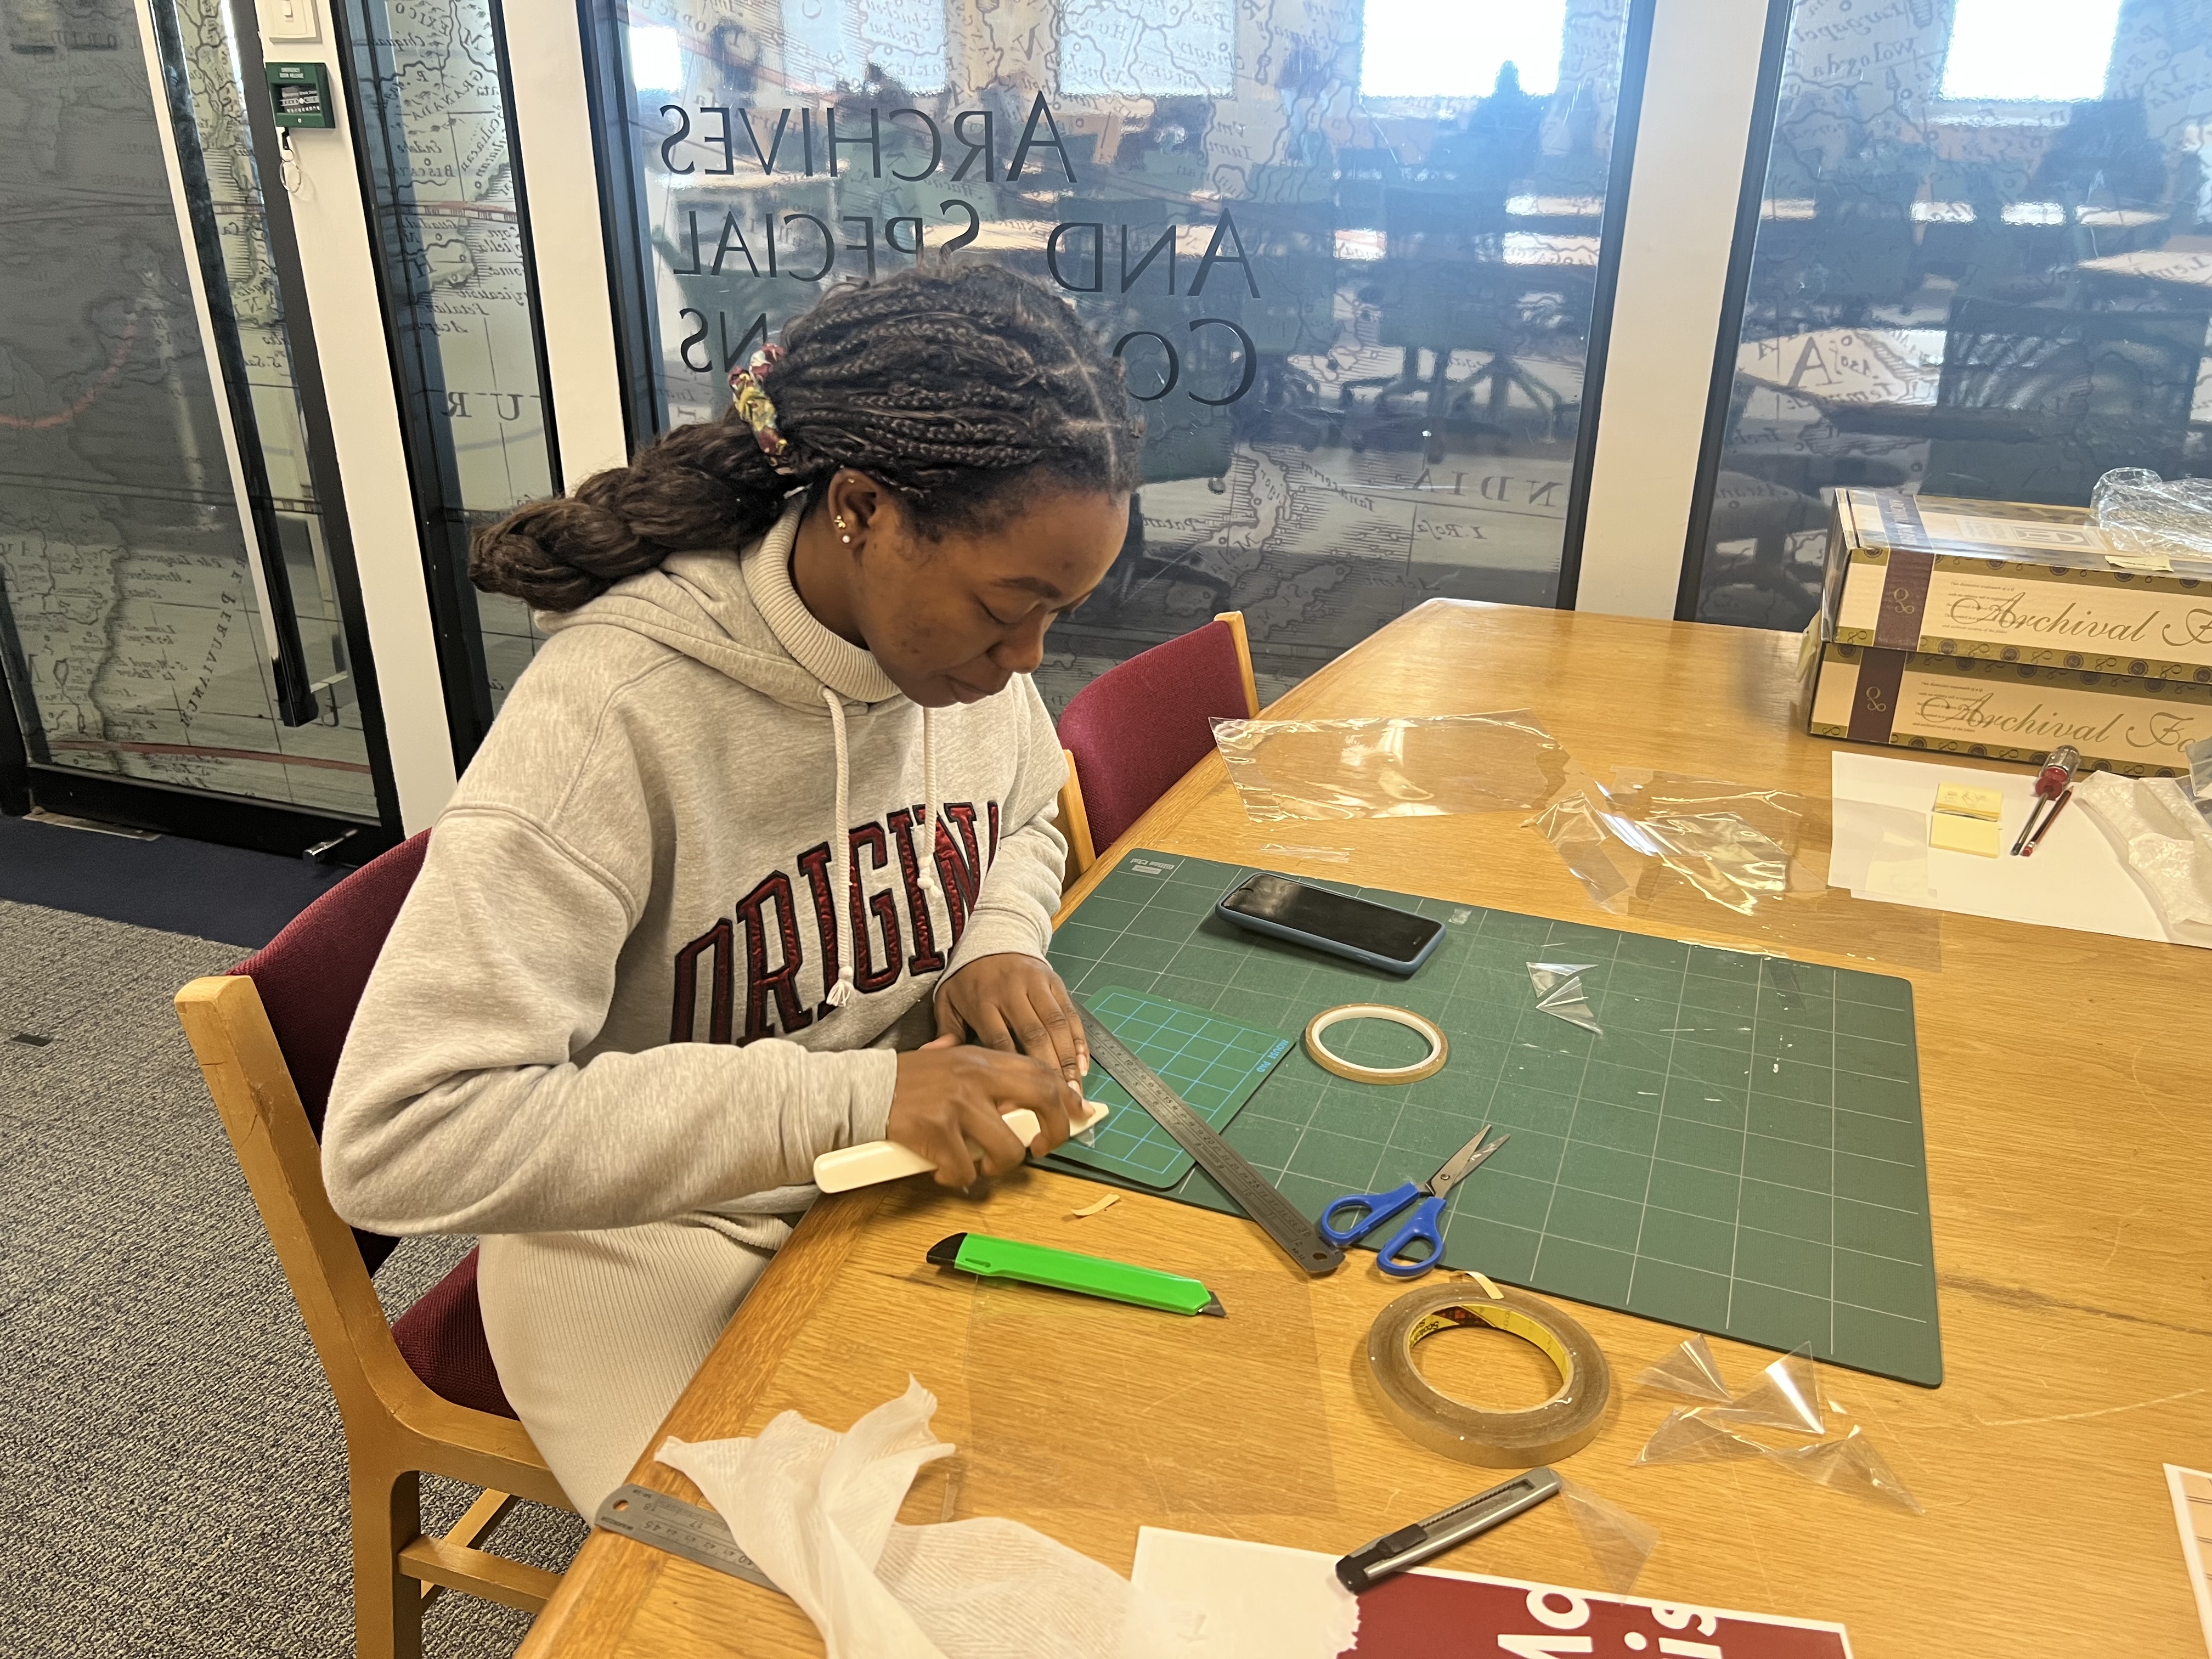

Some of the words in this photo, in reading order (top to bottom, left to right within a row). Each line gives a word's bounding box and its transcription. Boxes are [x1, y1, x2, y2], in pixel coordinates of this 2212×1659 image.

[1950, 591, 2160, 642] Archival
[1921, 692, 2124, 743] Archival
[670, 800, 998, 1047] ORIGIN
[1256, 1060, 1272, 1073] PAD
[1267, 1039, 1289, 1059] MOUSE
[1204, 1136, 1215, 1145] 20
[1249, 1180, 1261, 1189] 25
[644, 1520, 661, 1532] 45
